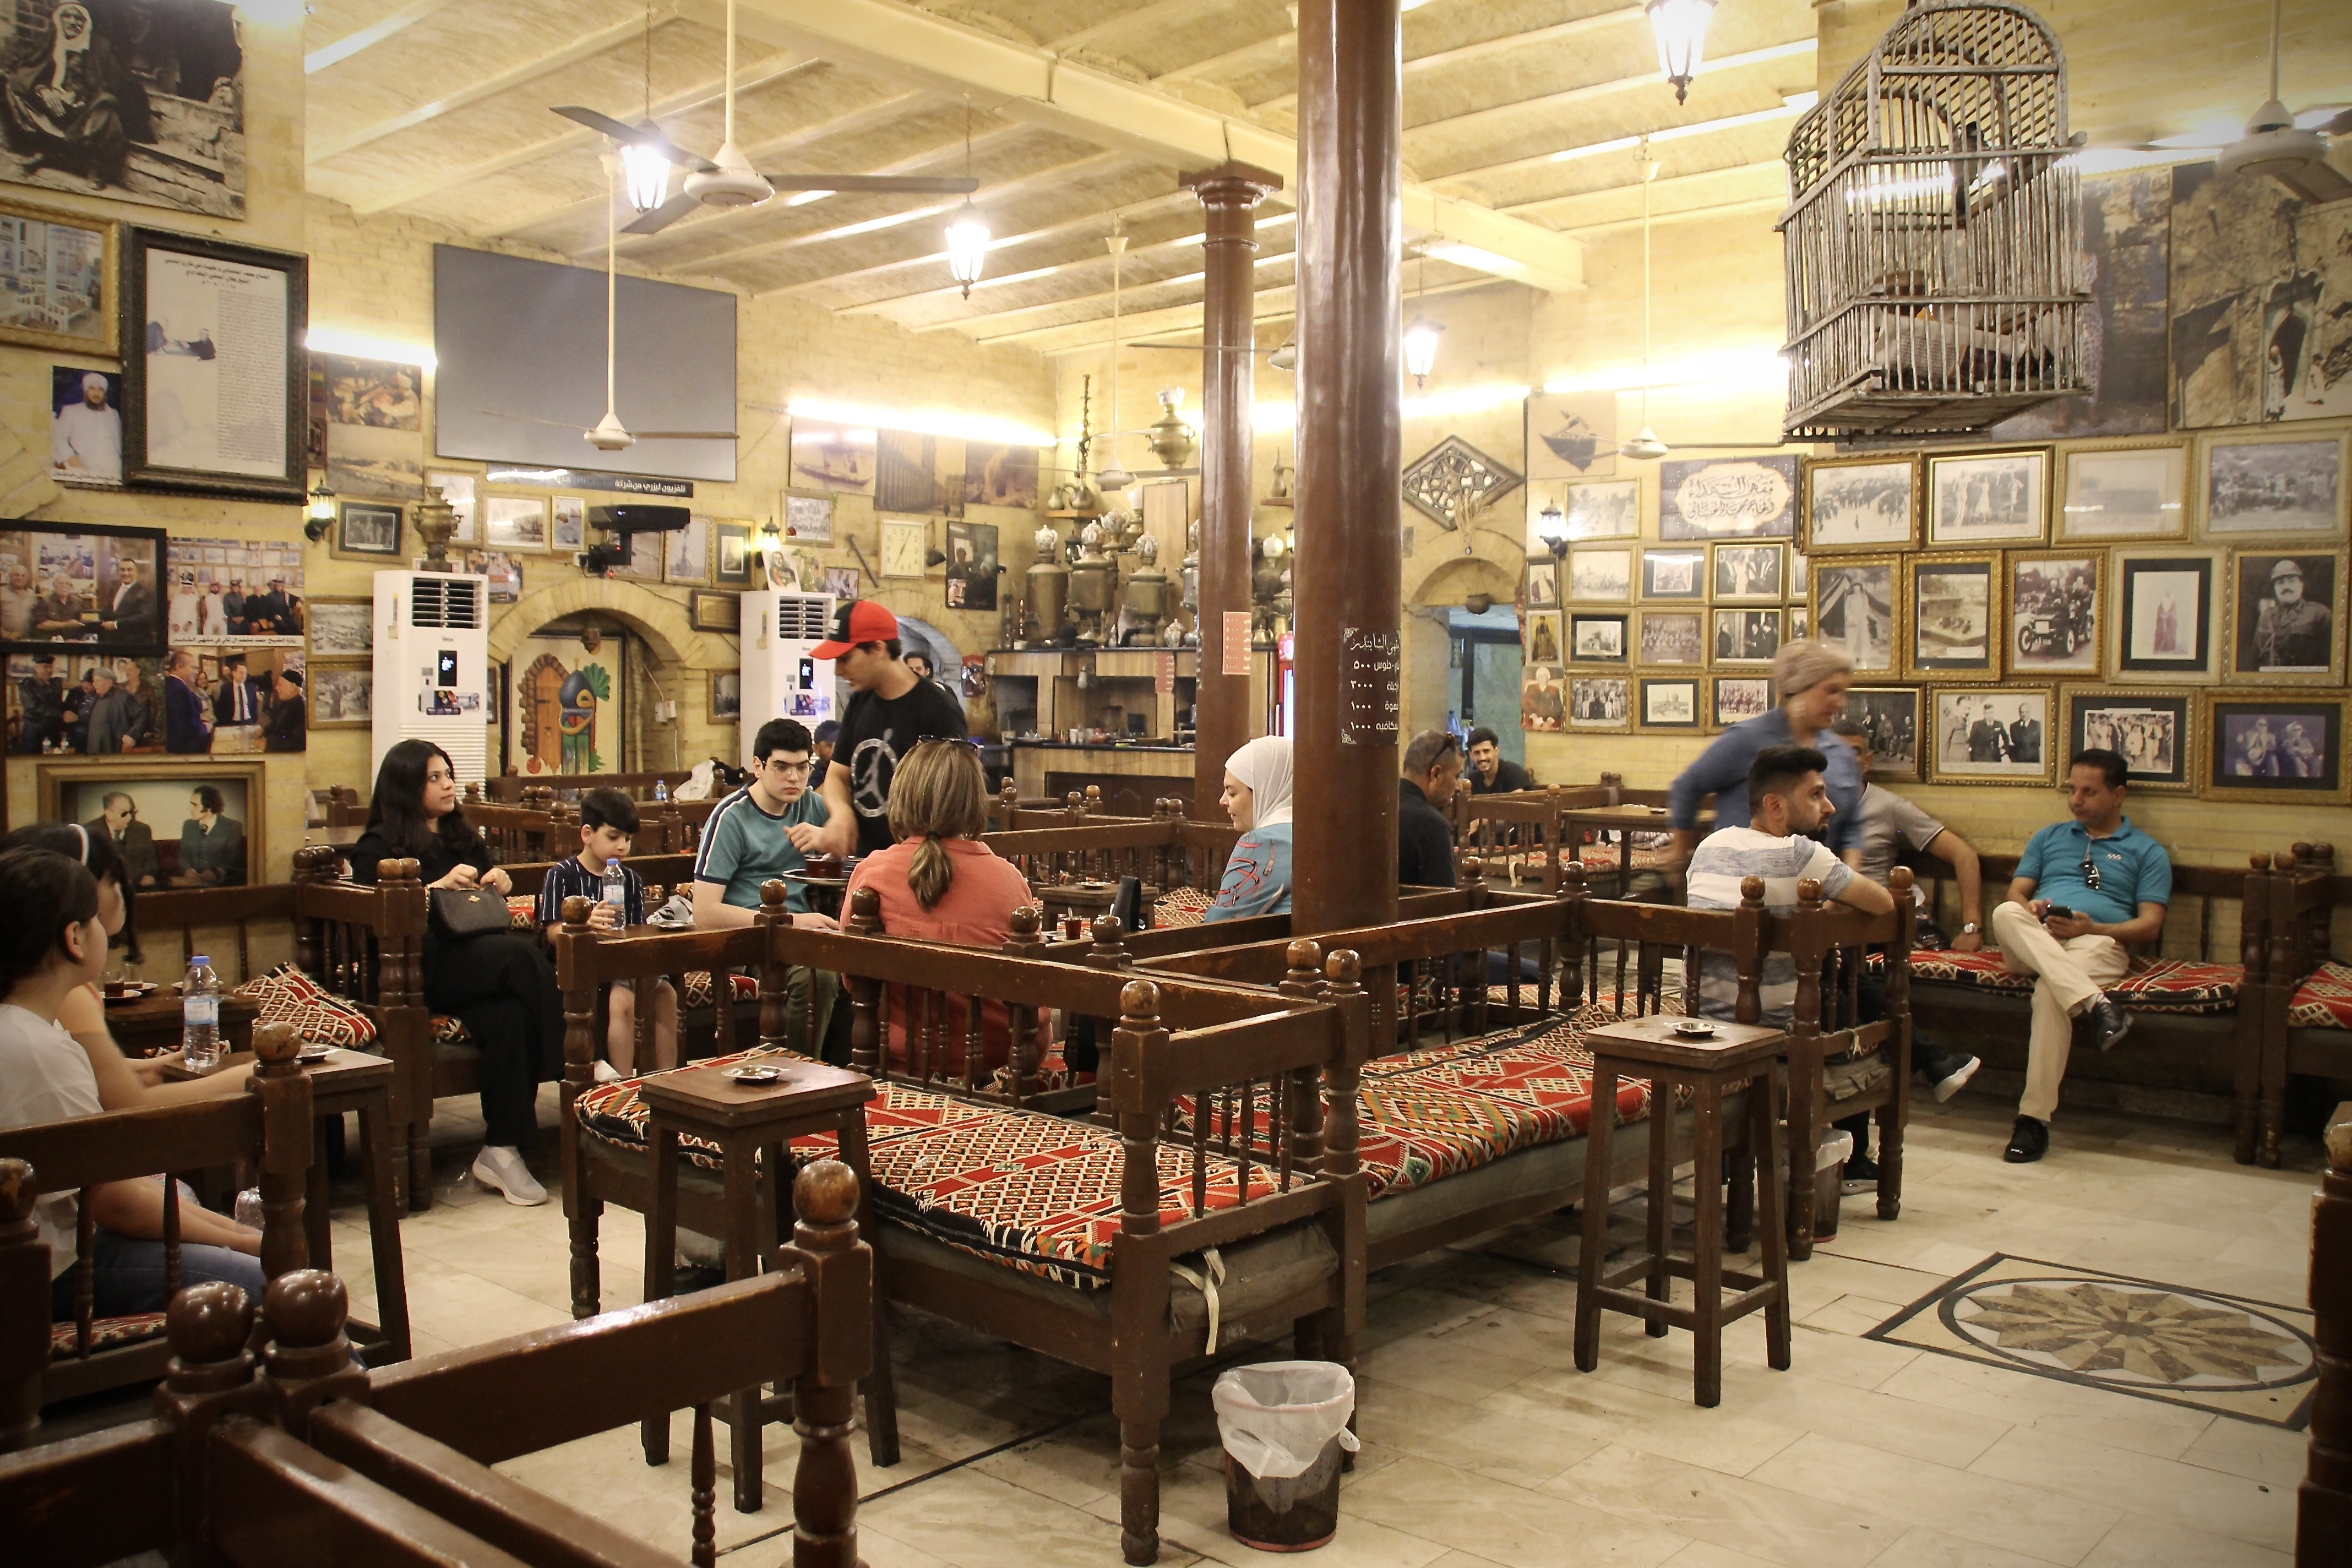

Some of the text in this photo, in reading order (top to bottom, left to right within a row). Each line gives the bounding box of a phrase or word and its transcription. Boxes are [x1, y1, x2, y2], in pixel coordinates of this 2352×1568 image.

[614, 478, 632, 489] شركة
[632, 482, 642, 490] من
[643, 481, 661, 491] ليزري
[661, 483, 686, 493] تلفزيون
[1350, 632, 1386, 651] الشابندر
[1353, 660, 1370, 669] ٥٠٠
[1351, 701, 1371, 710] ١٠٠٠
[1350, 721, 1371, 731] ١٠٠٠
